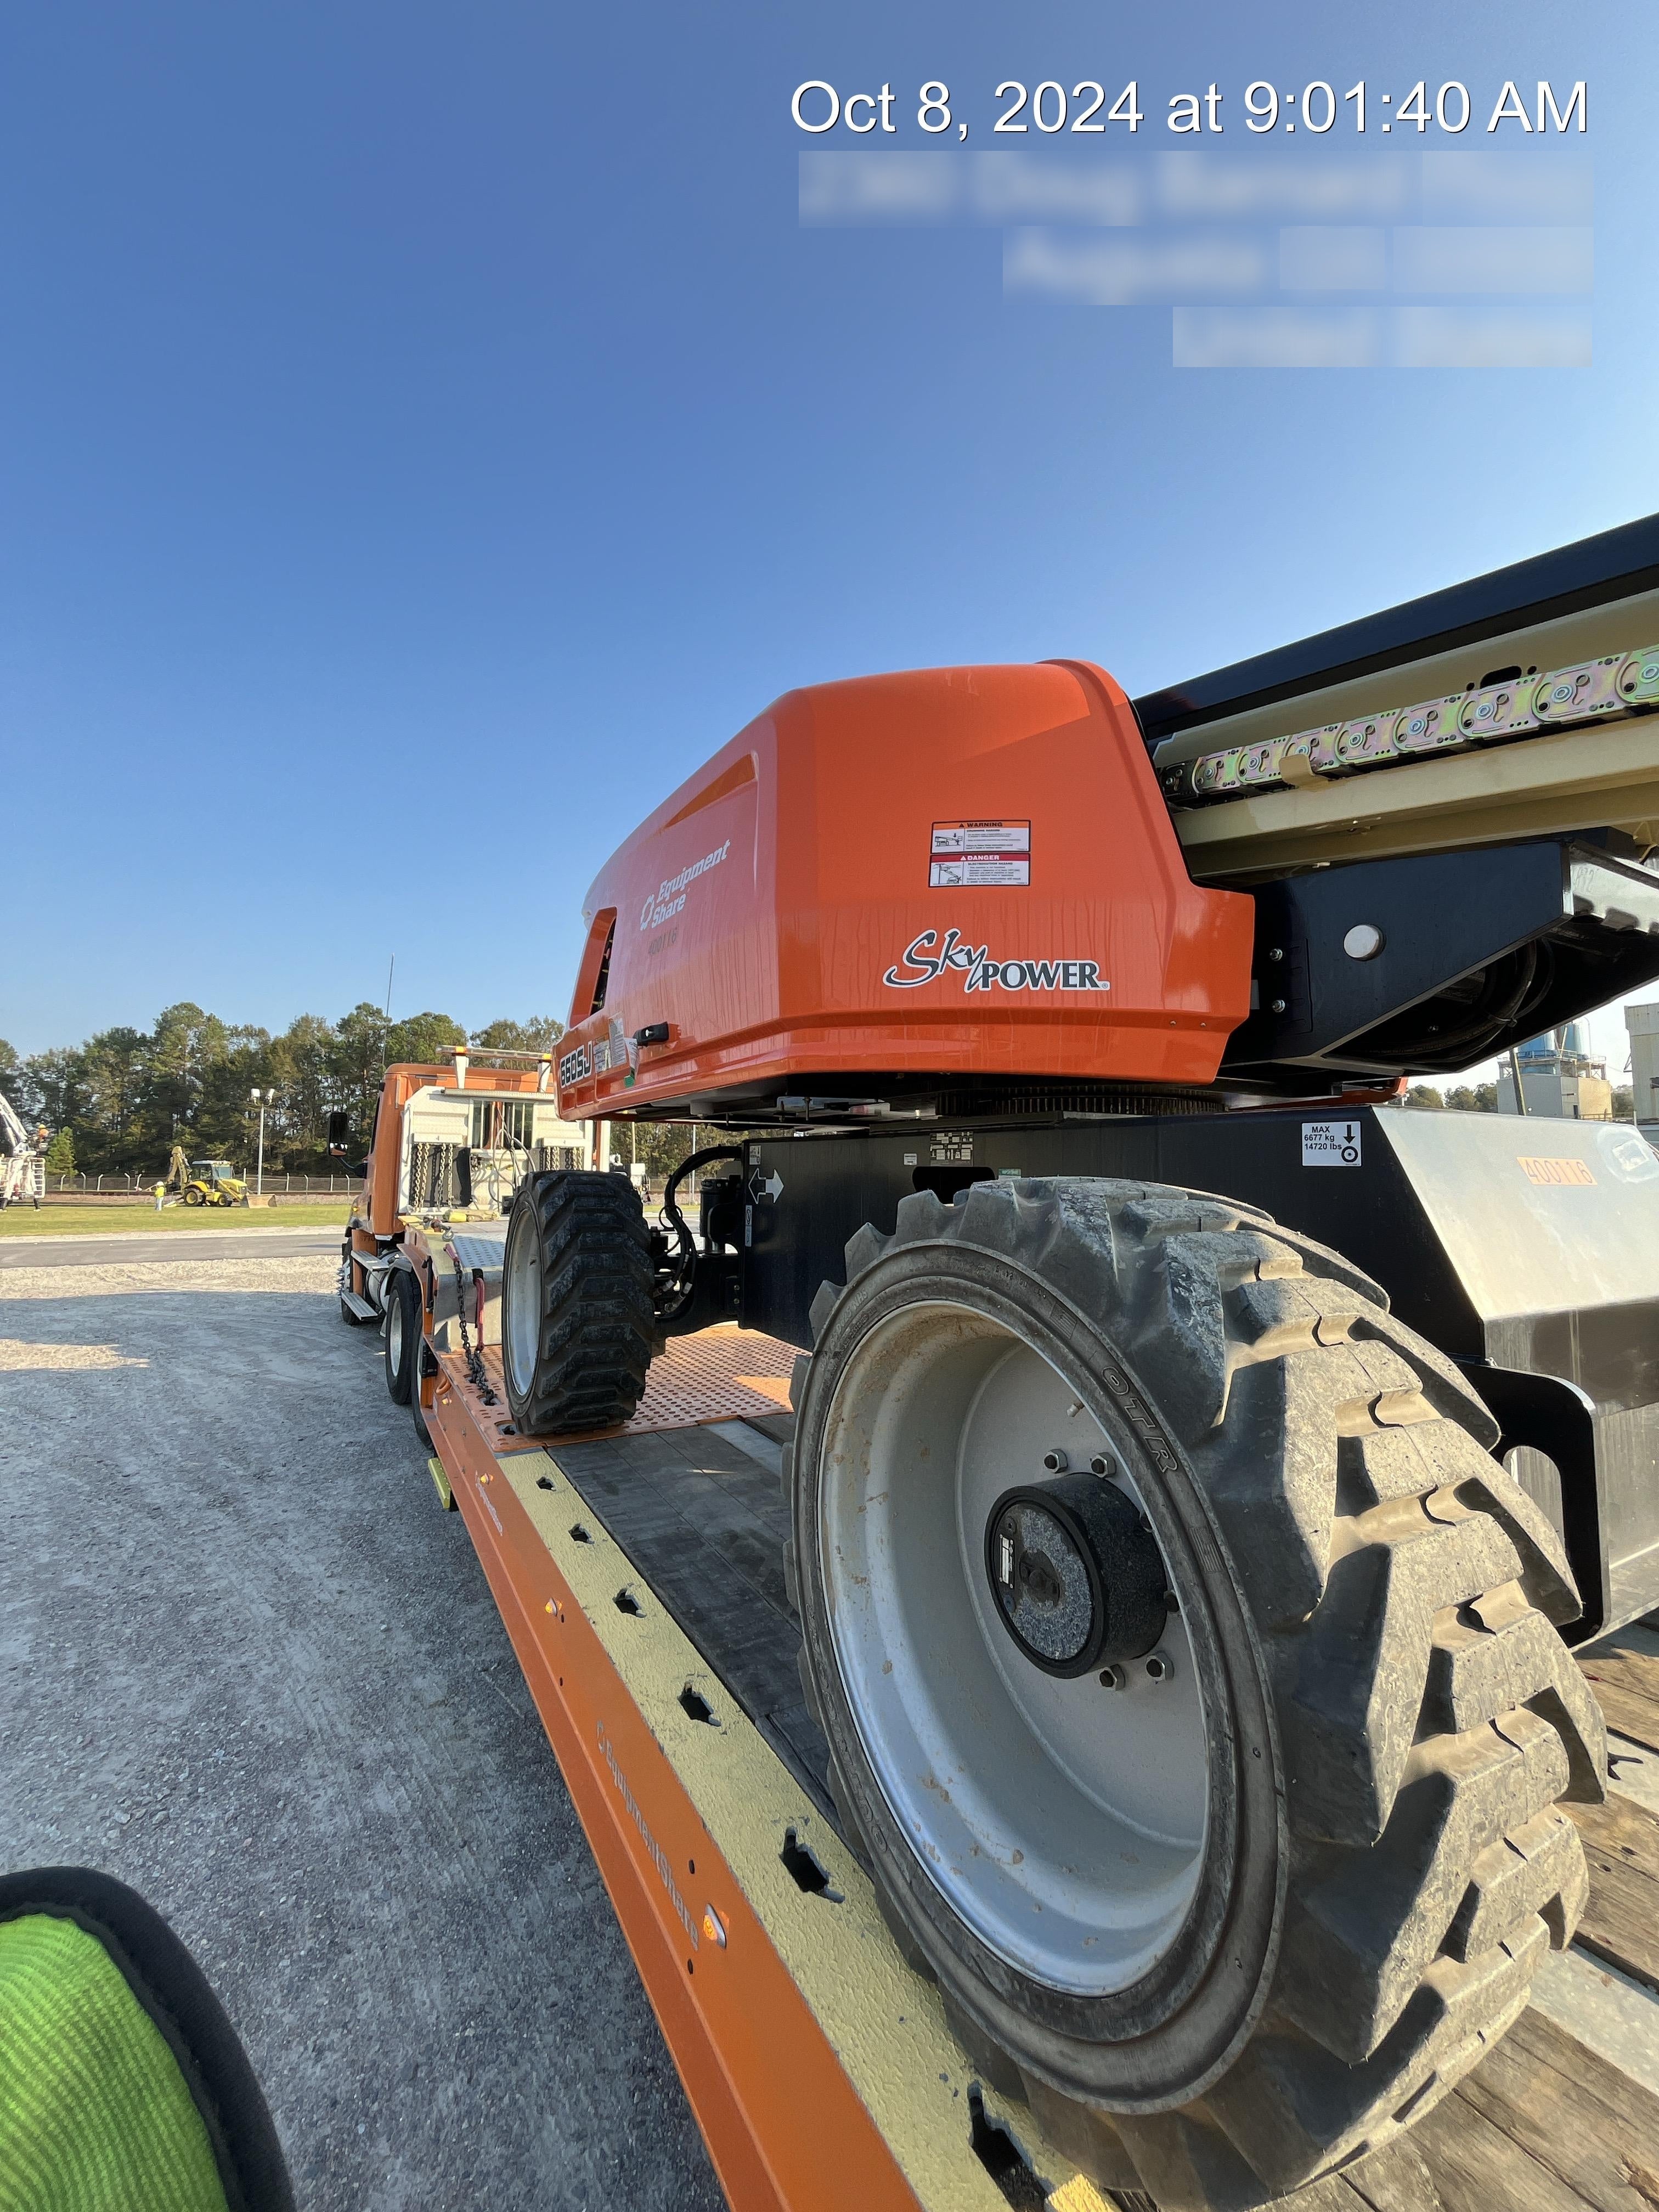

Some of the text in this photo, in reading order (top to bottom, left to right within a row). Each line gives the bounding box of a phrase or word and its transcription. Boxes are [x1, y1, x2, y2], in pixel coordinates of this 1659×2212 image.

[657, 839, 731, 903] Equipment
[651, 893, 687, 928] Share
[884, 929, 1101, 992] Sky POWER
[560, 1040, 592, 1088] 660SJ
[1324, 1133, 1335, 1142] kg
[1525, 1159, 1593, 1184] 400116
[1101, 1366, 1178, 1474] OTR
